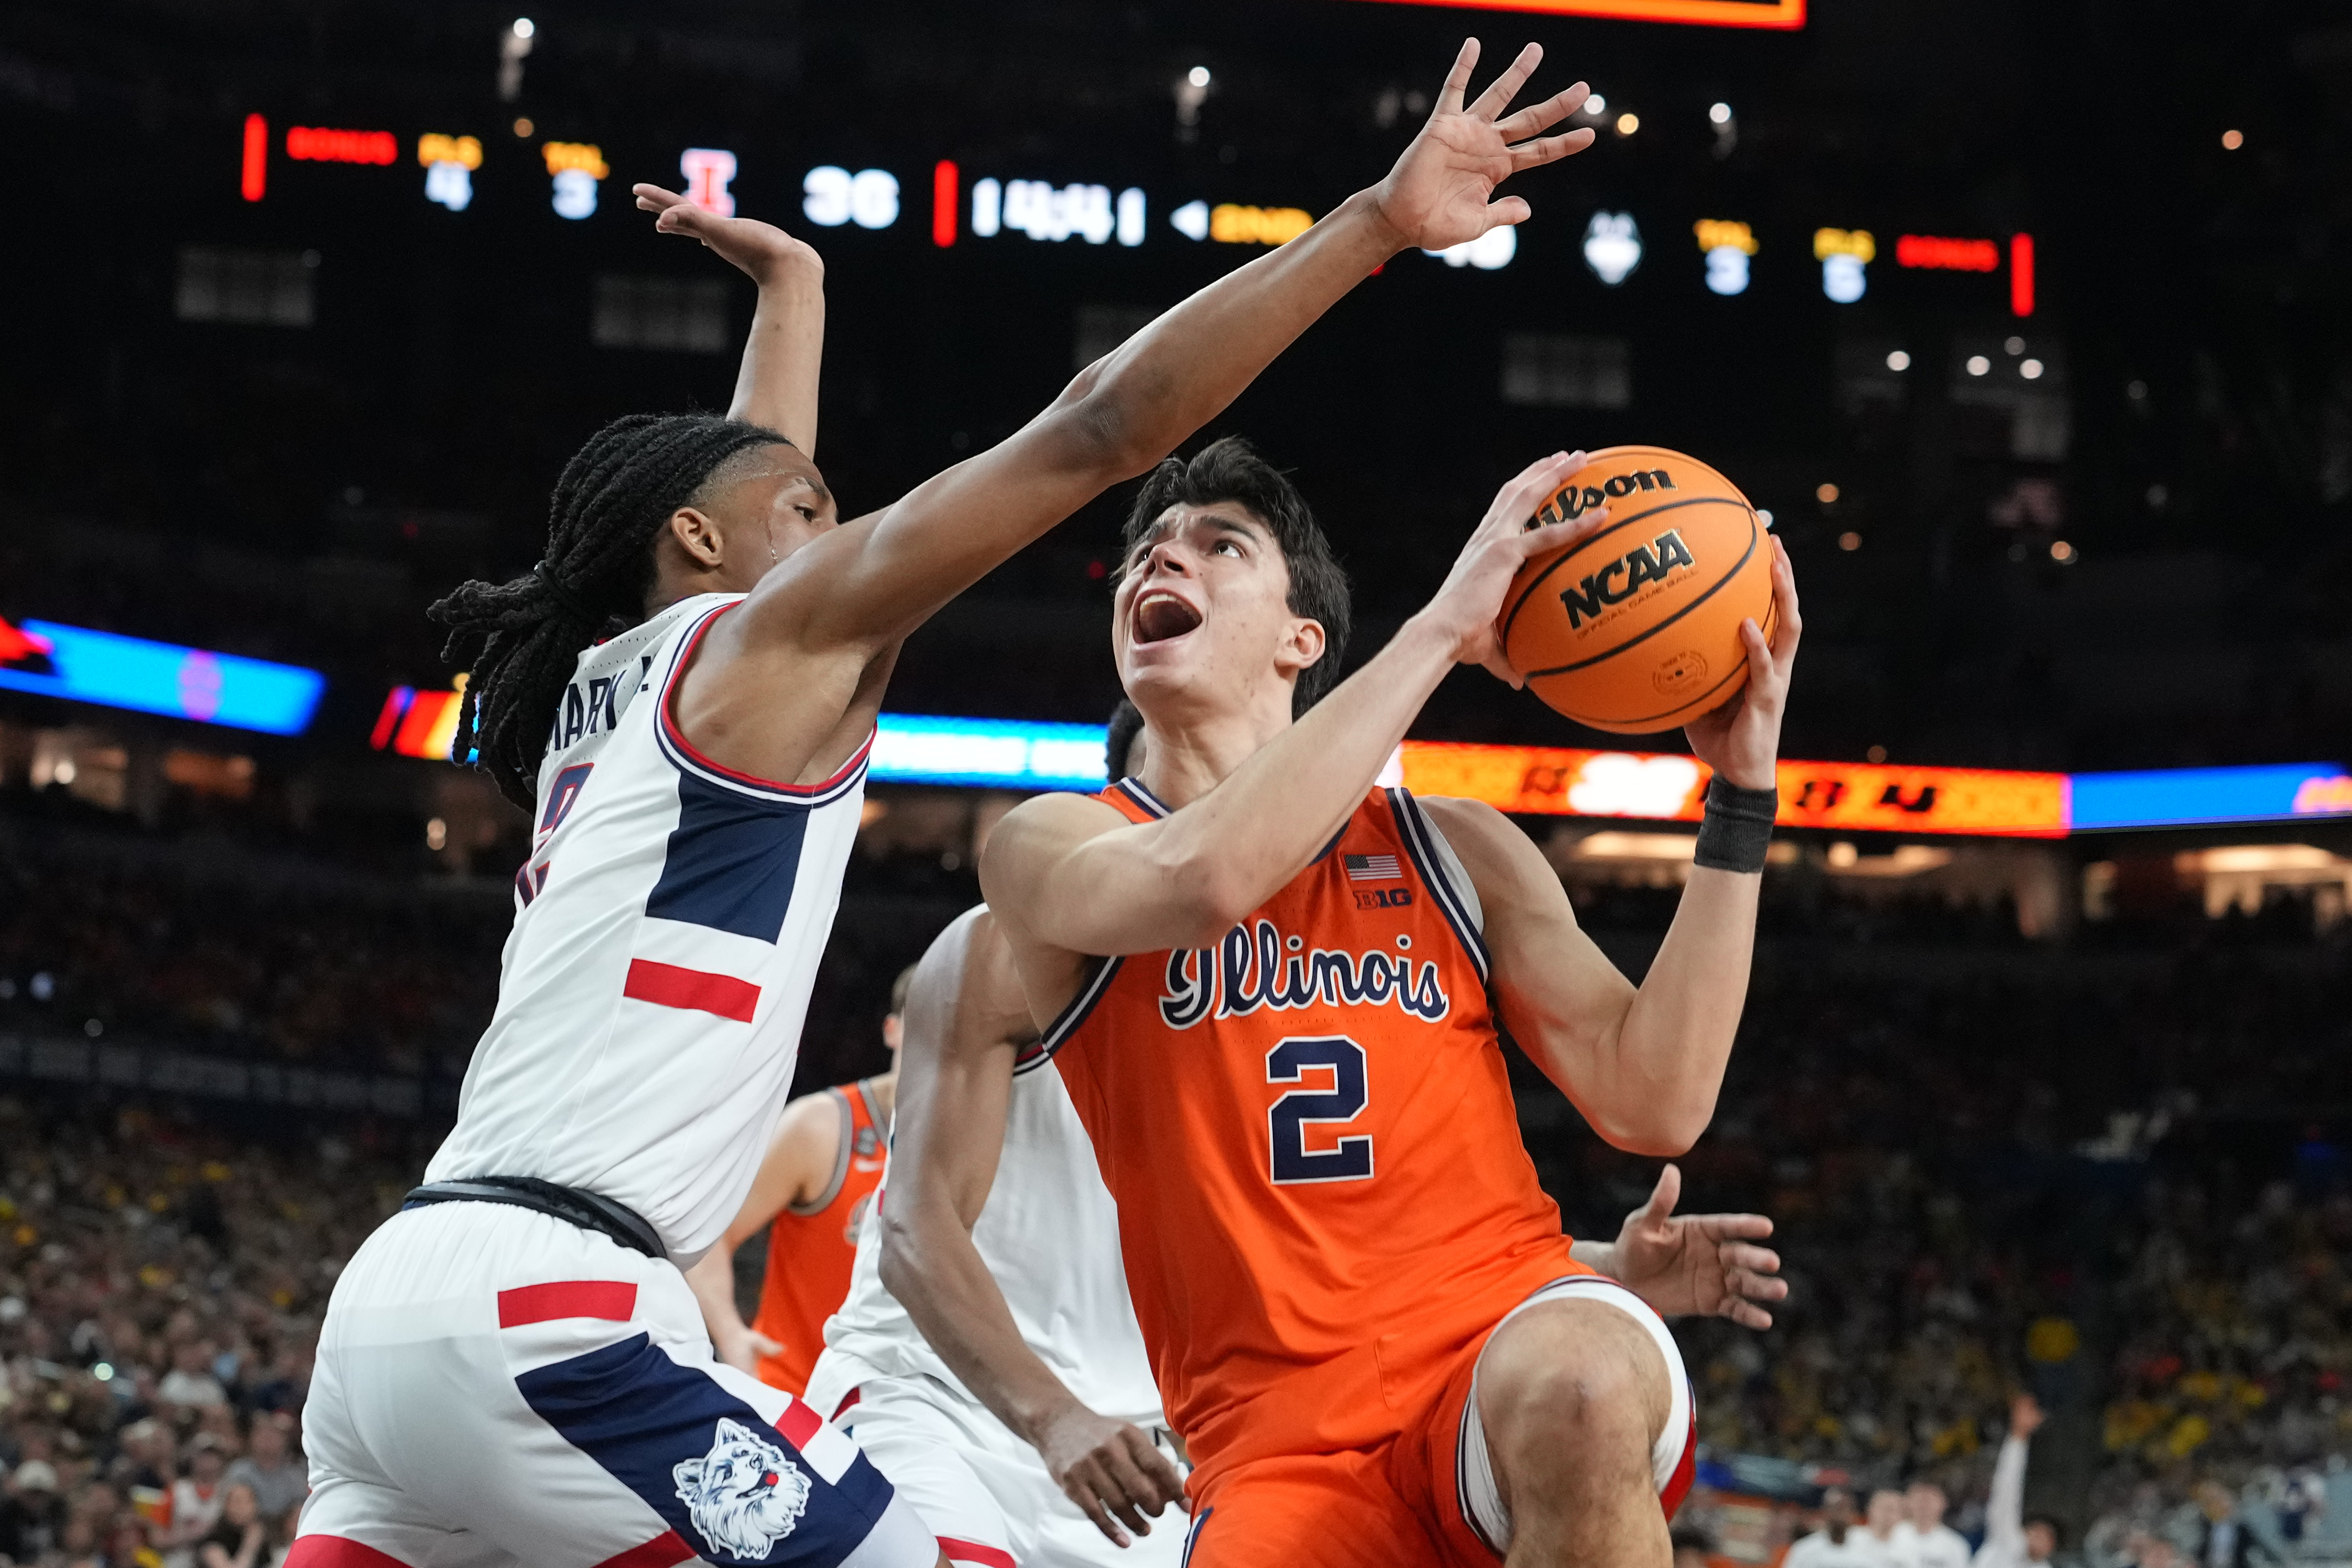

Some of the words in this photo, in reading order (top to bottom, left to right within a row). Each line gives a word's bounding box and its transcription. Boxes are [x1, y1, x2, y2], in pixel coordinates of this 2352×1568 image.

[1559, 528, 1696, 630] NCAA
[1158, 919, 1450, 1030] Illinois
[1265, 1034, 1374, 1185] 2
